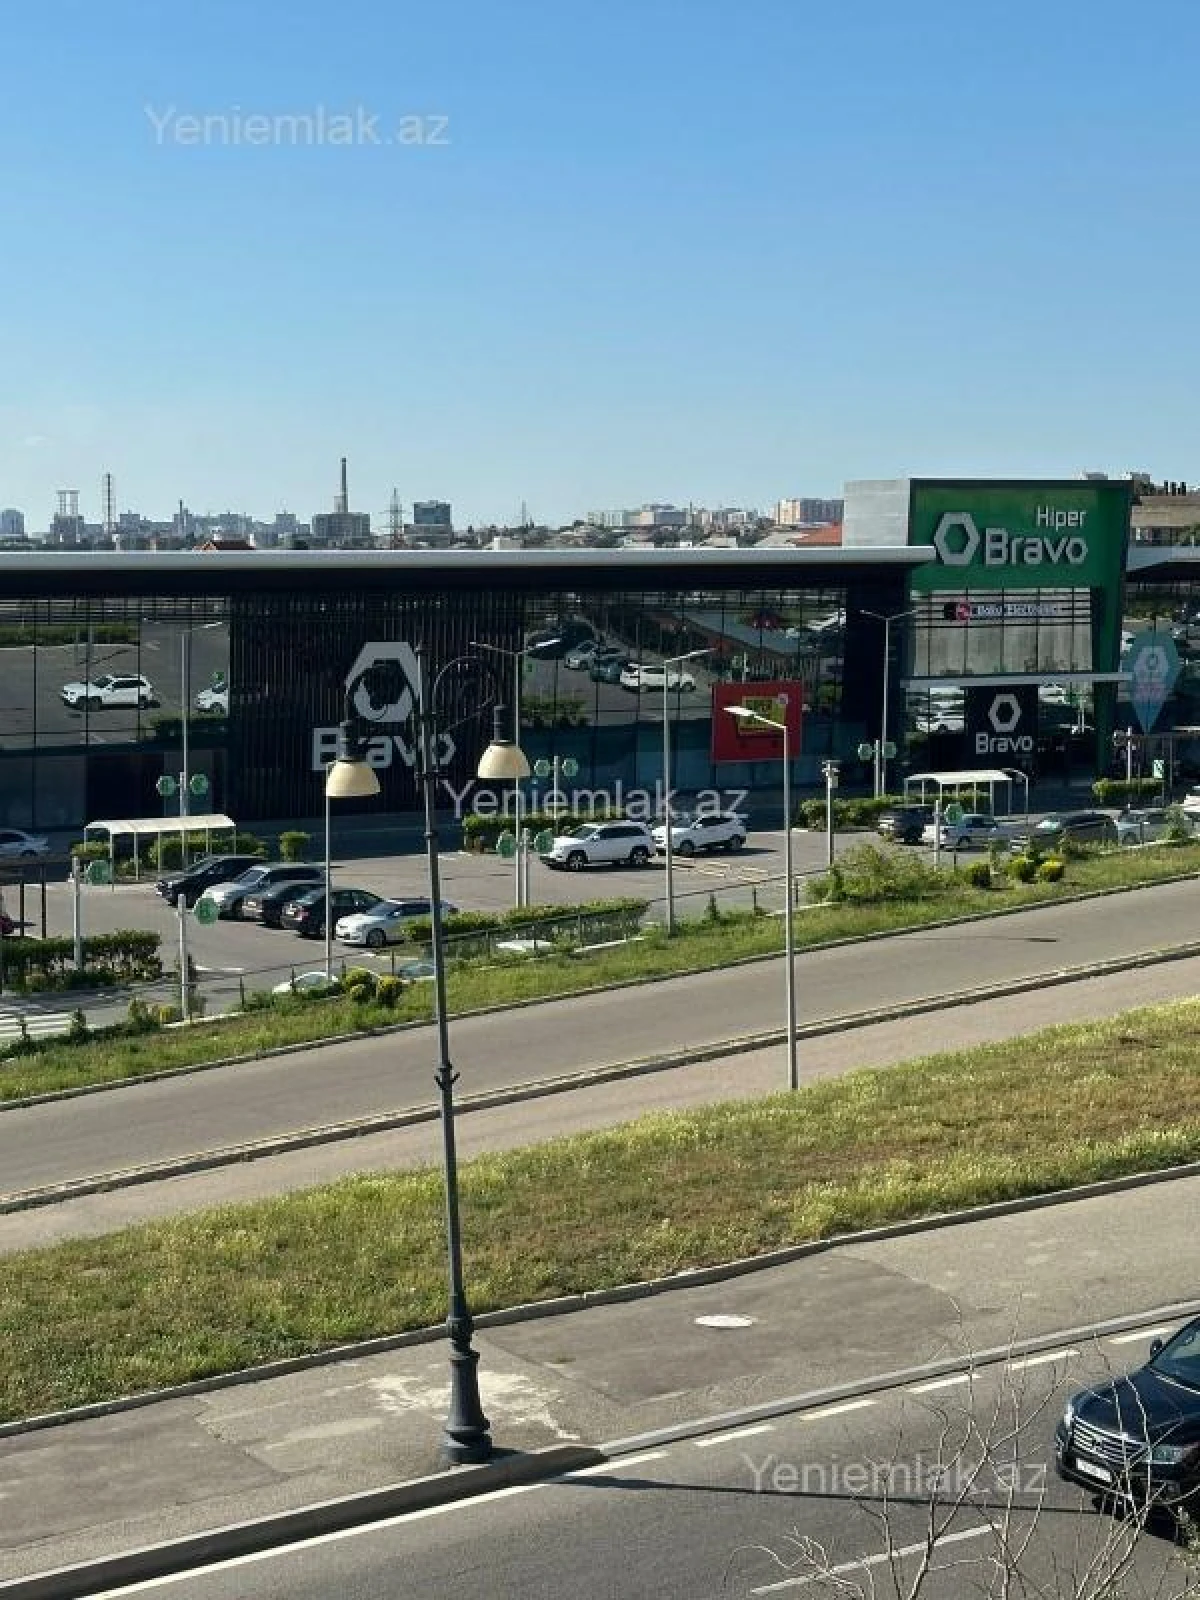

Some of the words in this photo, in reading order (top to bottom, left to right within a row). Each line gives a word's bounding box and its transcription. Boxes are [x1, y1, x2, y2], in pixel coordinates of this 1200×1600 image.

[1036, 505, 1087, 532] Hiper
[985, 527, 1089, 565] Bravo
[975, 731, 1034, 754] Bravo
